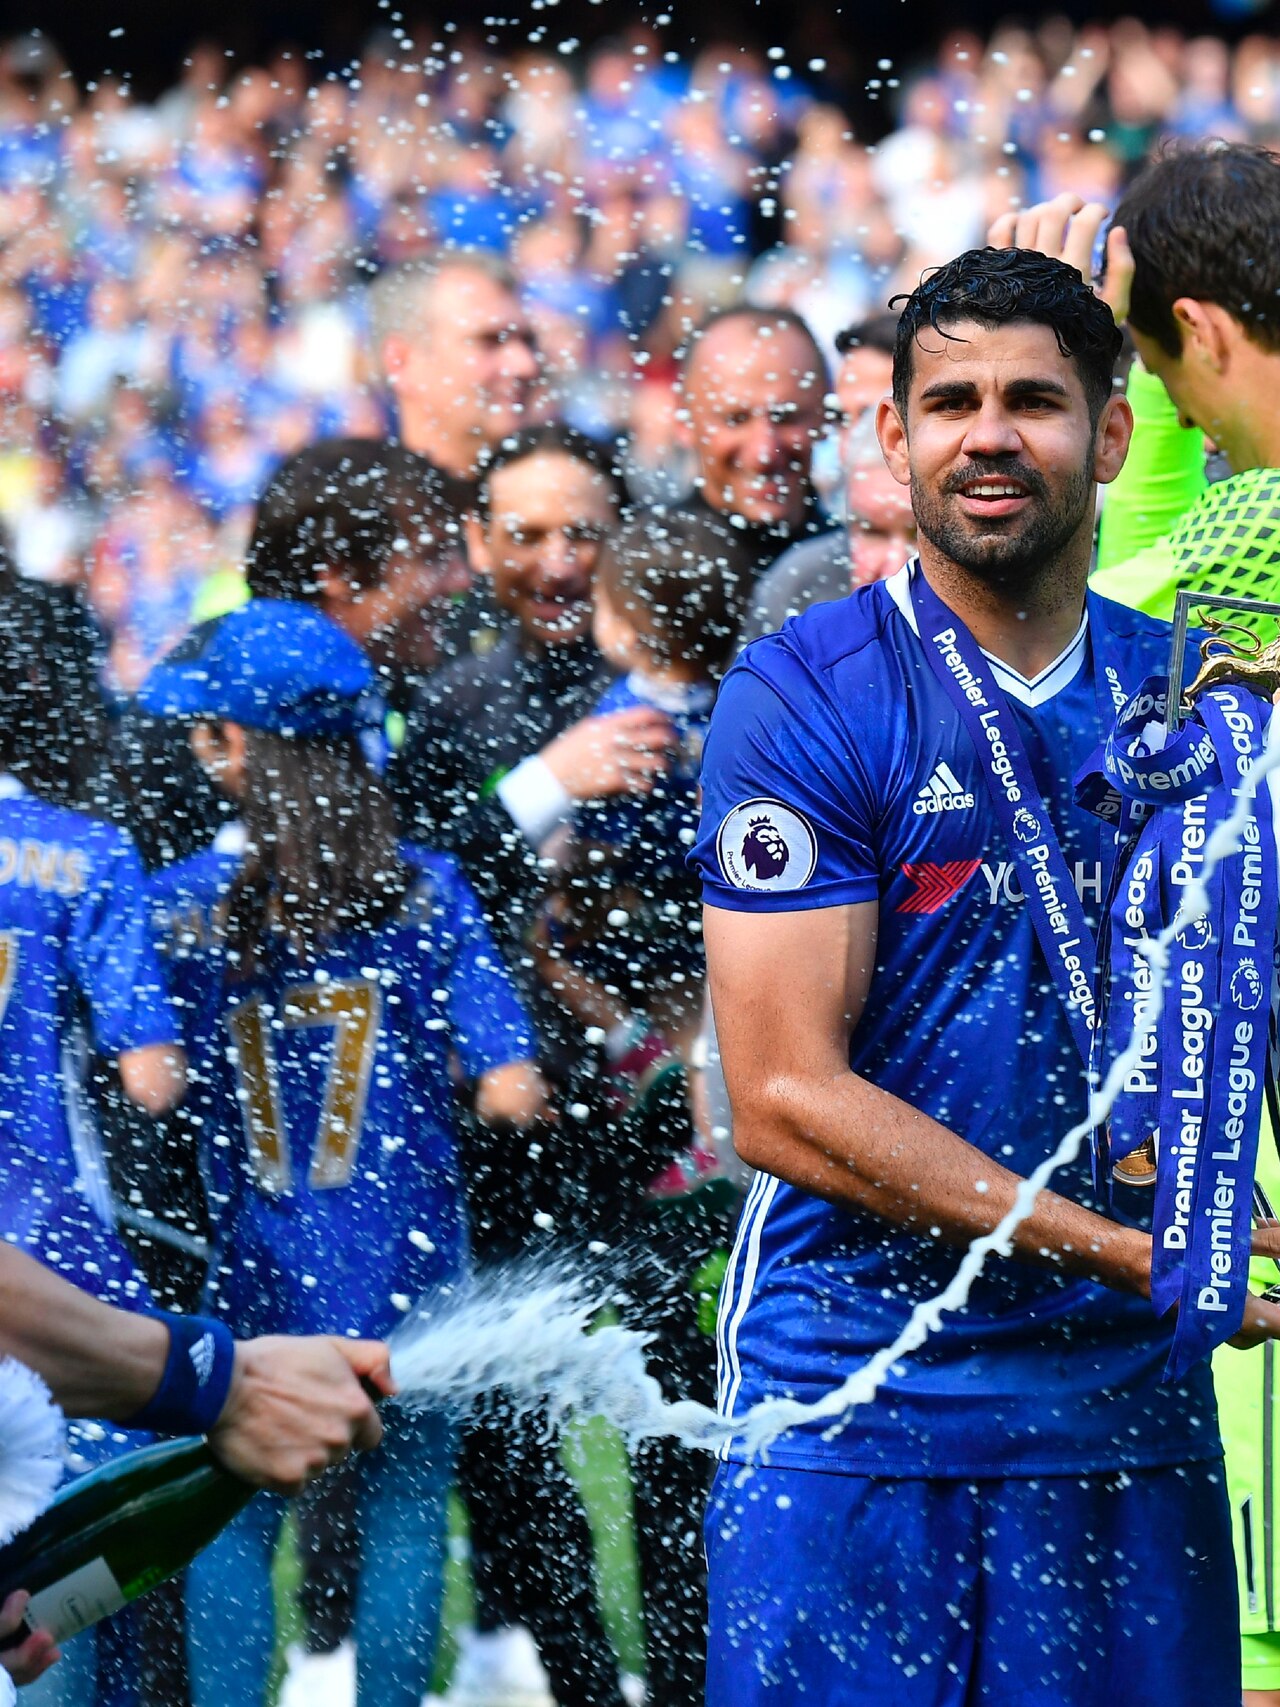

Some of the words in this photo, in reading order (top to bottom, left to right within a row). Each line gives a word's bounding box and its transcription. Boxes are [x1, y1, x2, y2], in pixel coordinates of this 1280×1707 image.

[931, 626, 989, 709] Premier
[977, 707, 1022, 803] League
[1116, 733, 1217, 790] Premier
[726, 850, 742, 882] Premier
[912, 790, 975, 815] adidas
[1025, 843, 1071, 936] Premier
[1058, 936, 1101, 1031] League
[224, 978, 380, 1192] 17
[1172, 960, 1213, 1100] League
[1212, 1020, 1256, 1162] League
[1197, 1169, 1240, 1312] Premier
